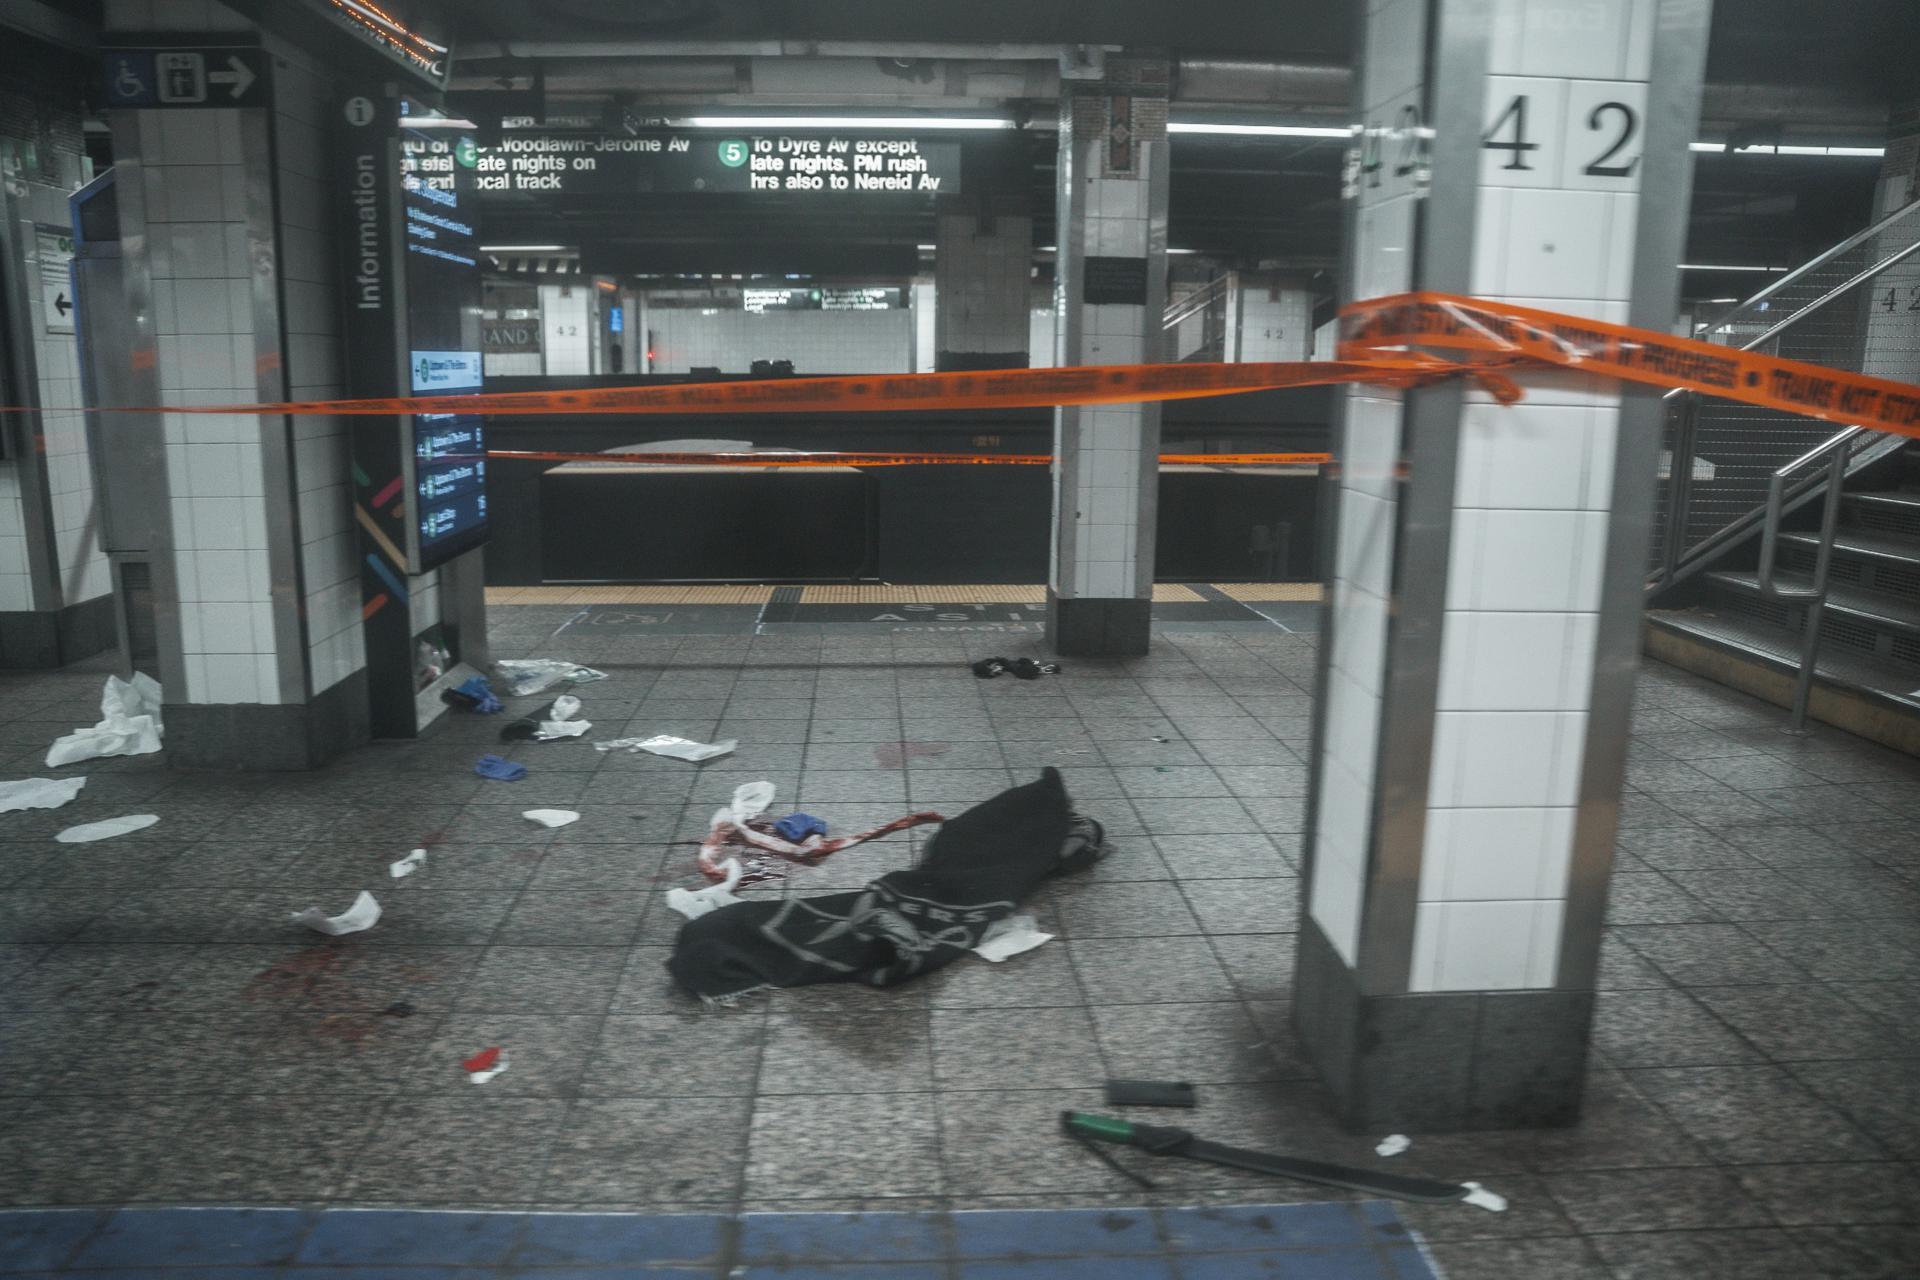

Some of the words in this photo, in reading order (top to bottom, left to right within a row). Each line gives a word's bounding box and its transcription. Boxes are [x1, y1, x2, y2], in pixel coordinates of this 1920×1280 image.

[668, 137, 690, 152] Av
[726, 143, 742, 161] 5
[778, 137, 821, 156] Dyre
[827, 137, 848, 152] Av
[856, 139, 917, 156] except
[477, 155, 507, 171] ate
[512, 154, 566, 173] nights
[573, 158, 596, 171] on
[750, 155, 784, 171] late
[854, 155, 882, 171] PM
[888, 155, 927, 171] rush
[477, 172, 510, 190] ocal
[515, 172, 562, 190] track
[751, 173, 780, 189] hrs
[785, 173, 824, 190] also
[830, 174, 849, 190] to
[854, 173, 912, 190] Nereid
[918, 174, 941, 190] Av
[352, 154, 381, 309] Information
